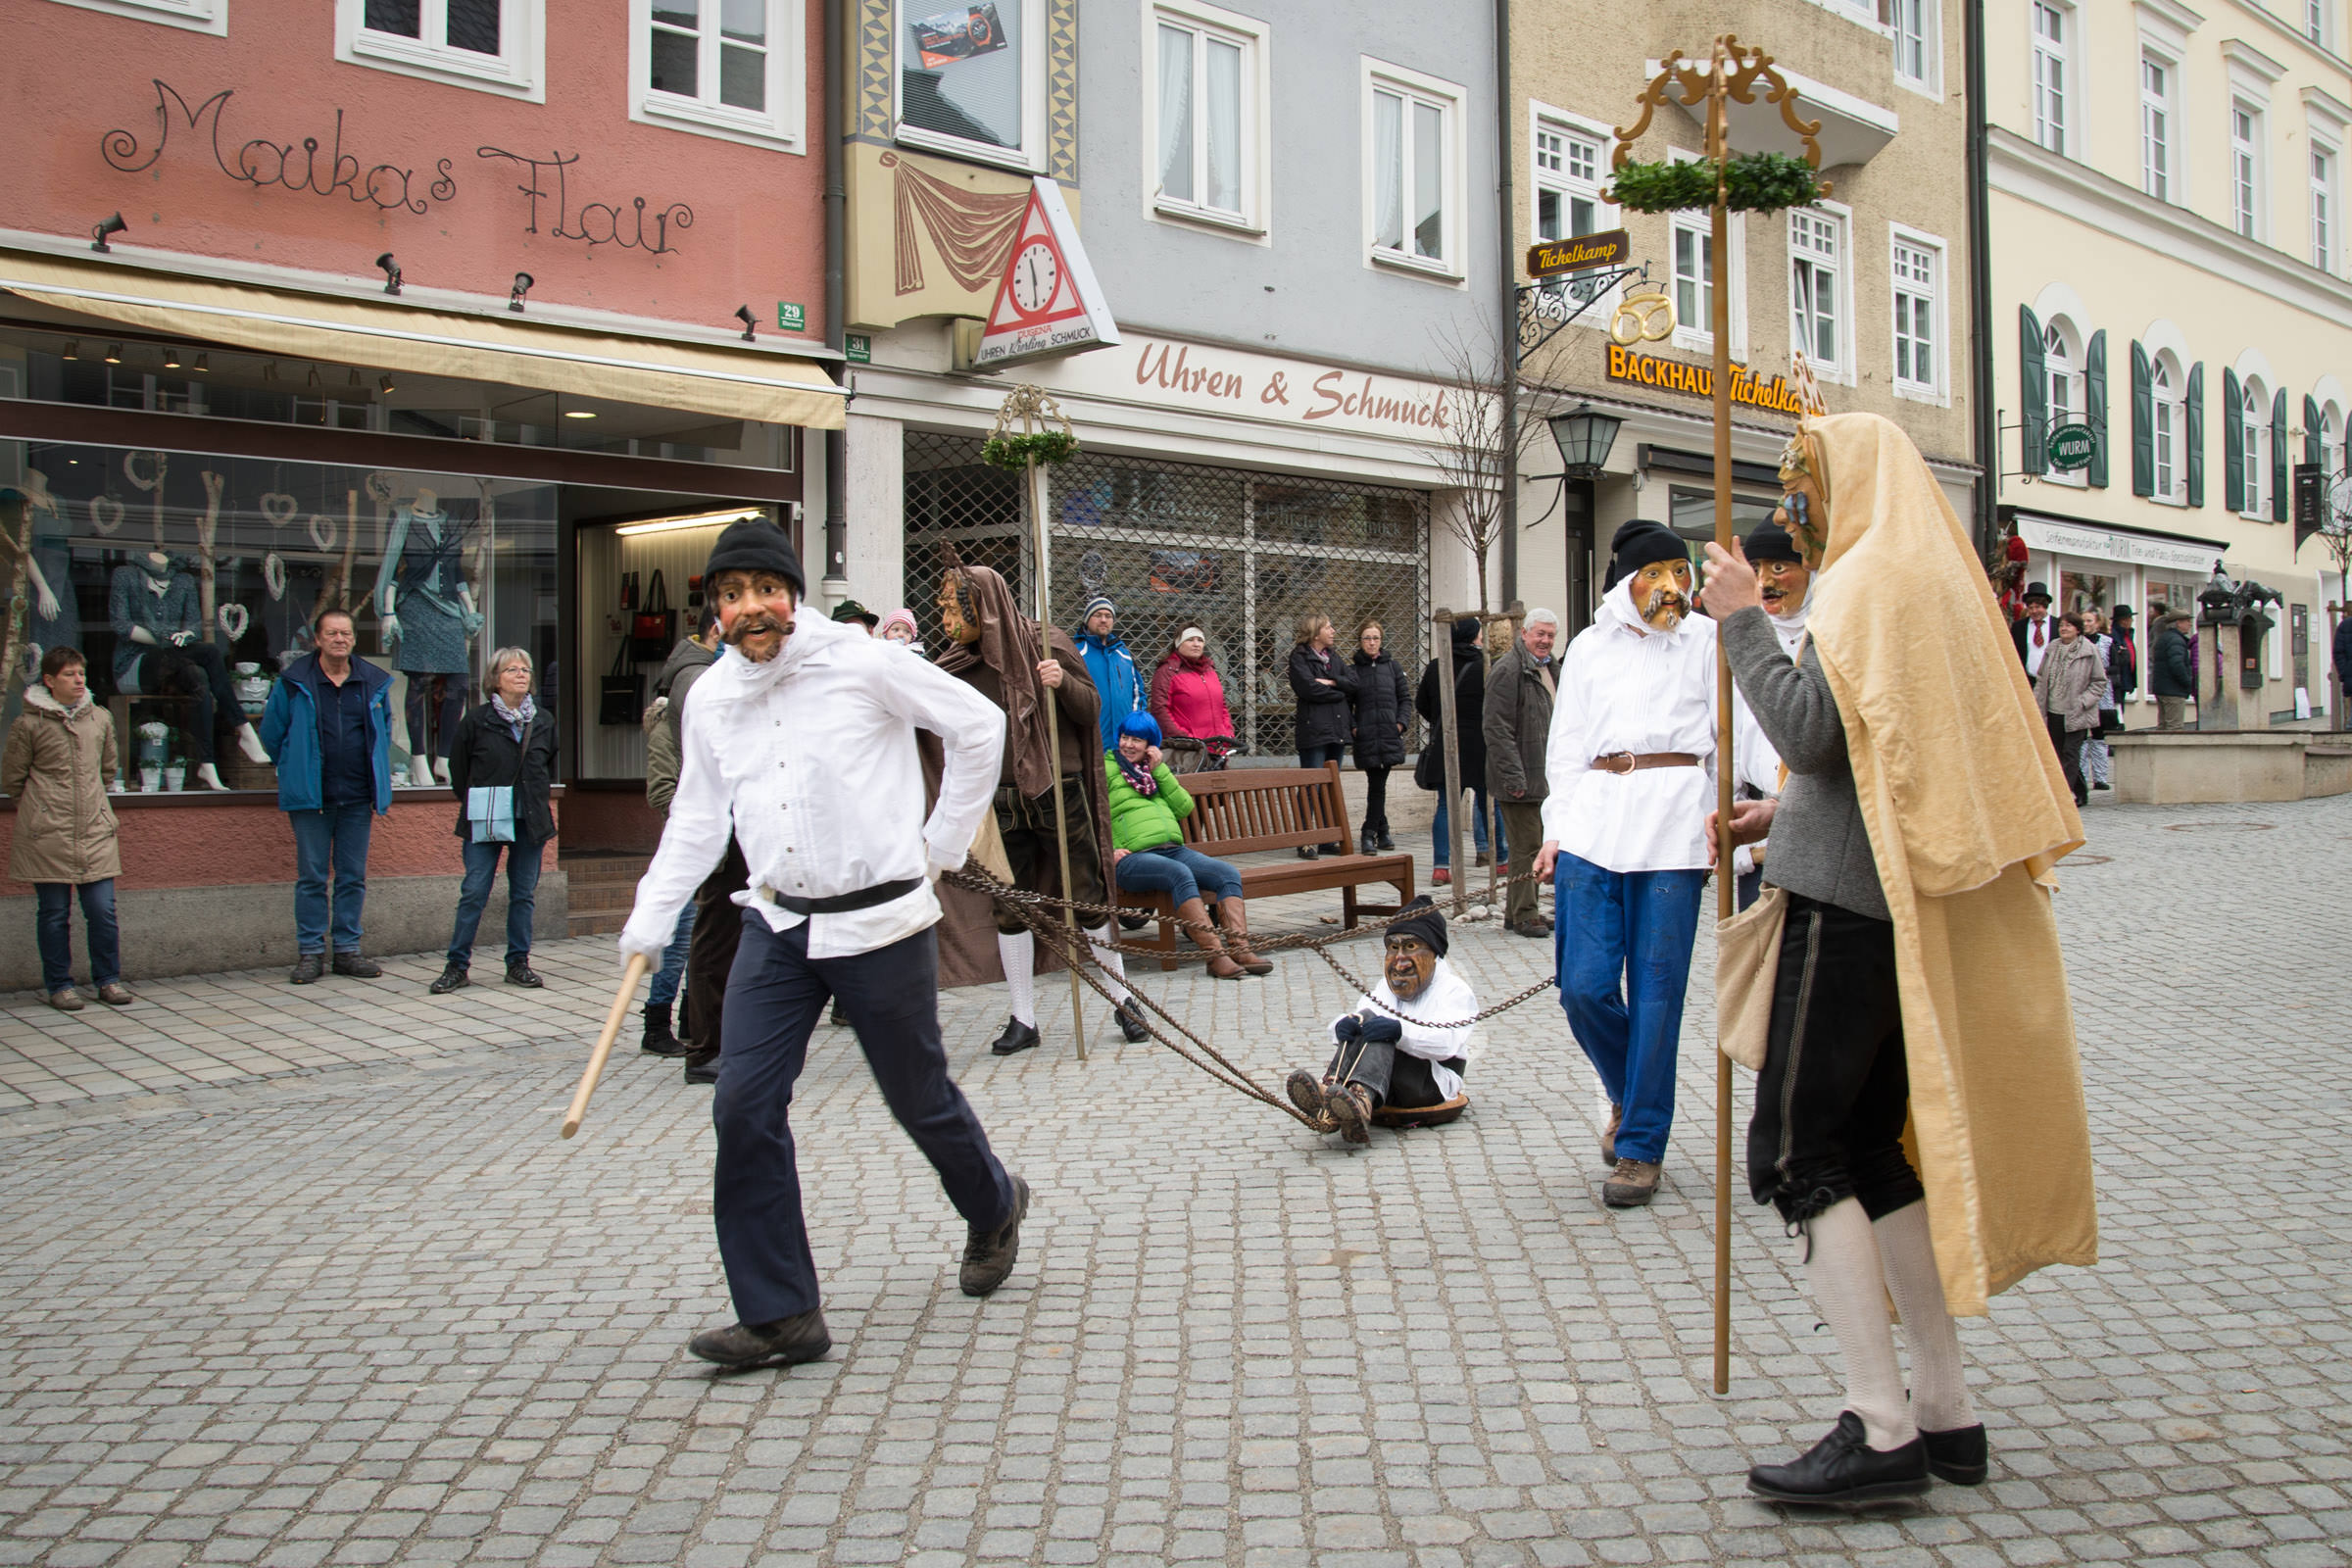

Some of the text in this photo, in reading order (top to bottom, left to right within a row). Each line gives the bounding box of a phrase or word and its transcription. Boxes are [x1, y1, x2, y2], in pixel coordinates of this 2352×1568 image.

[101, 78, 694, 256] Maikas Flair
[1538, 242, 1618, 270] Tichelkamp
[783, 304, 801, 318] 29
[851, 336, 865, 351] 31
[980, 346, 1006, 361] UHREN
[1051, 326, 1092, 346] SCHMUCK
[1016, 324, 1053, 338] DUGENA
[1609, 345, 1714, 395] BACKHAU
[1136, 343, 1450, 429] Uhren & Schmuck
[2059, 439, 2090, 456] WURM
